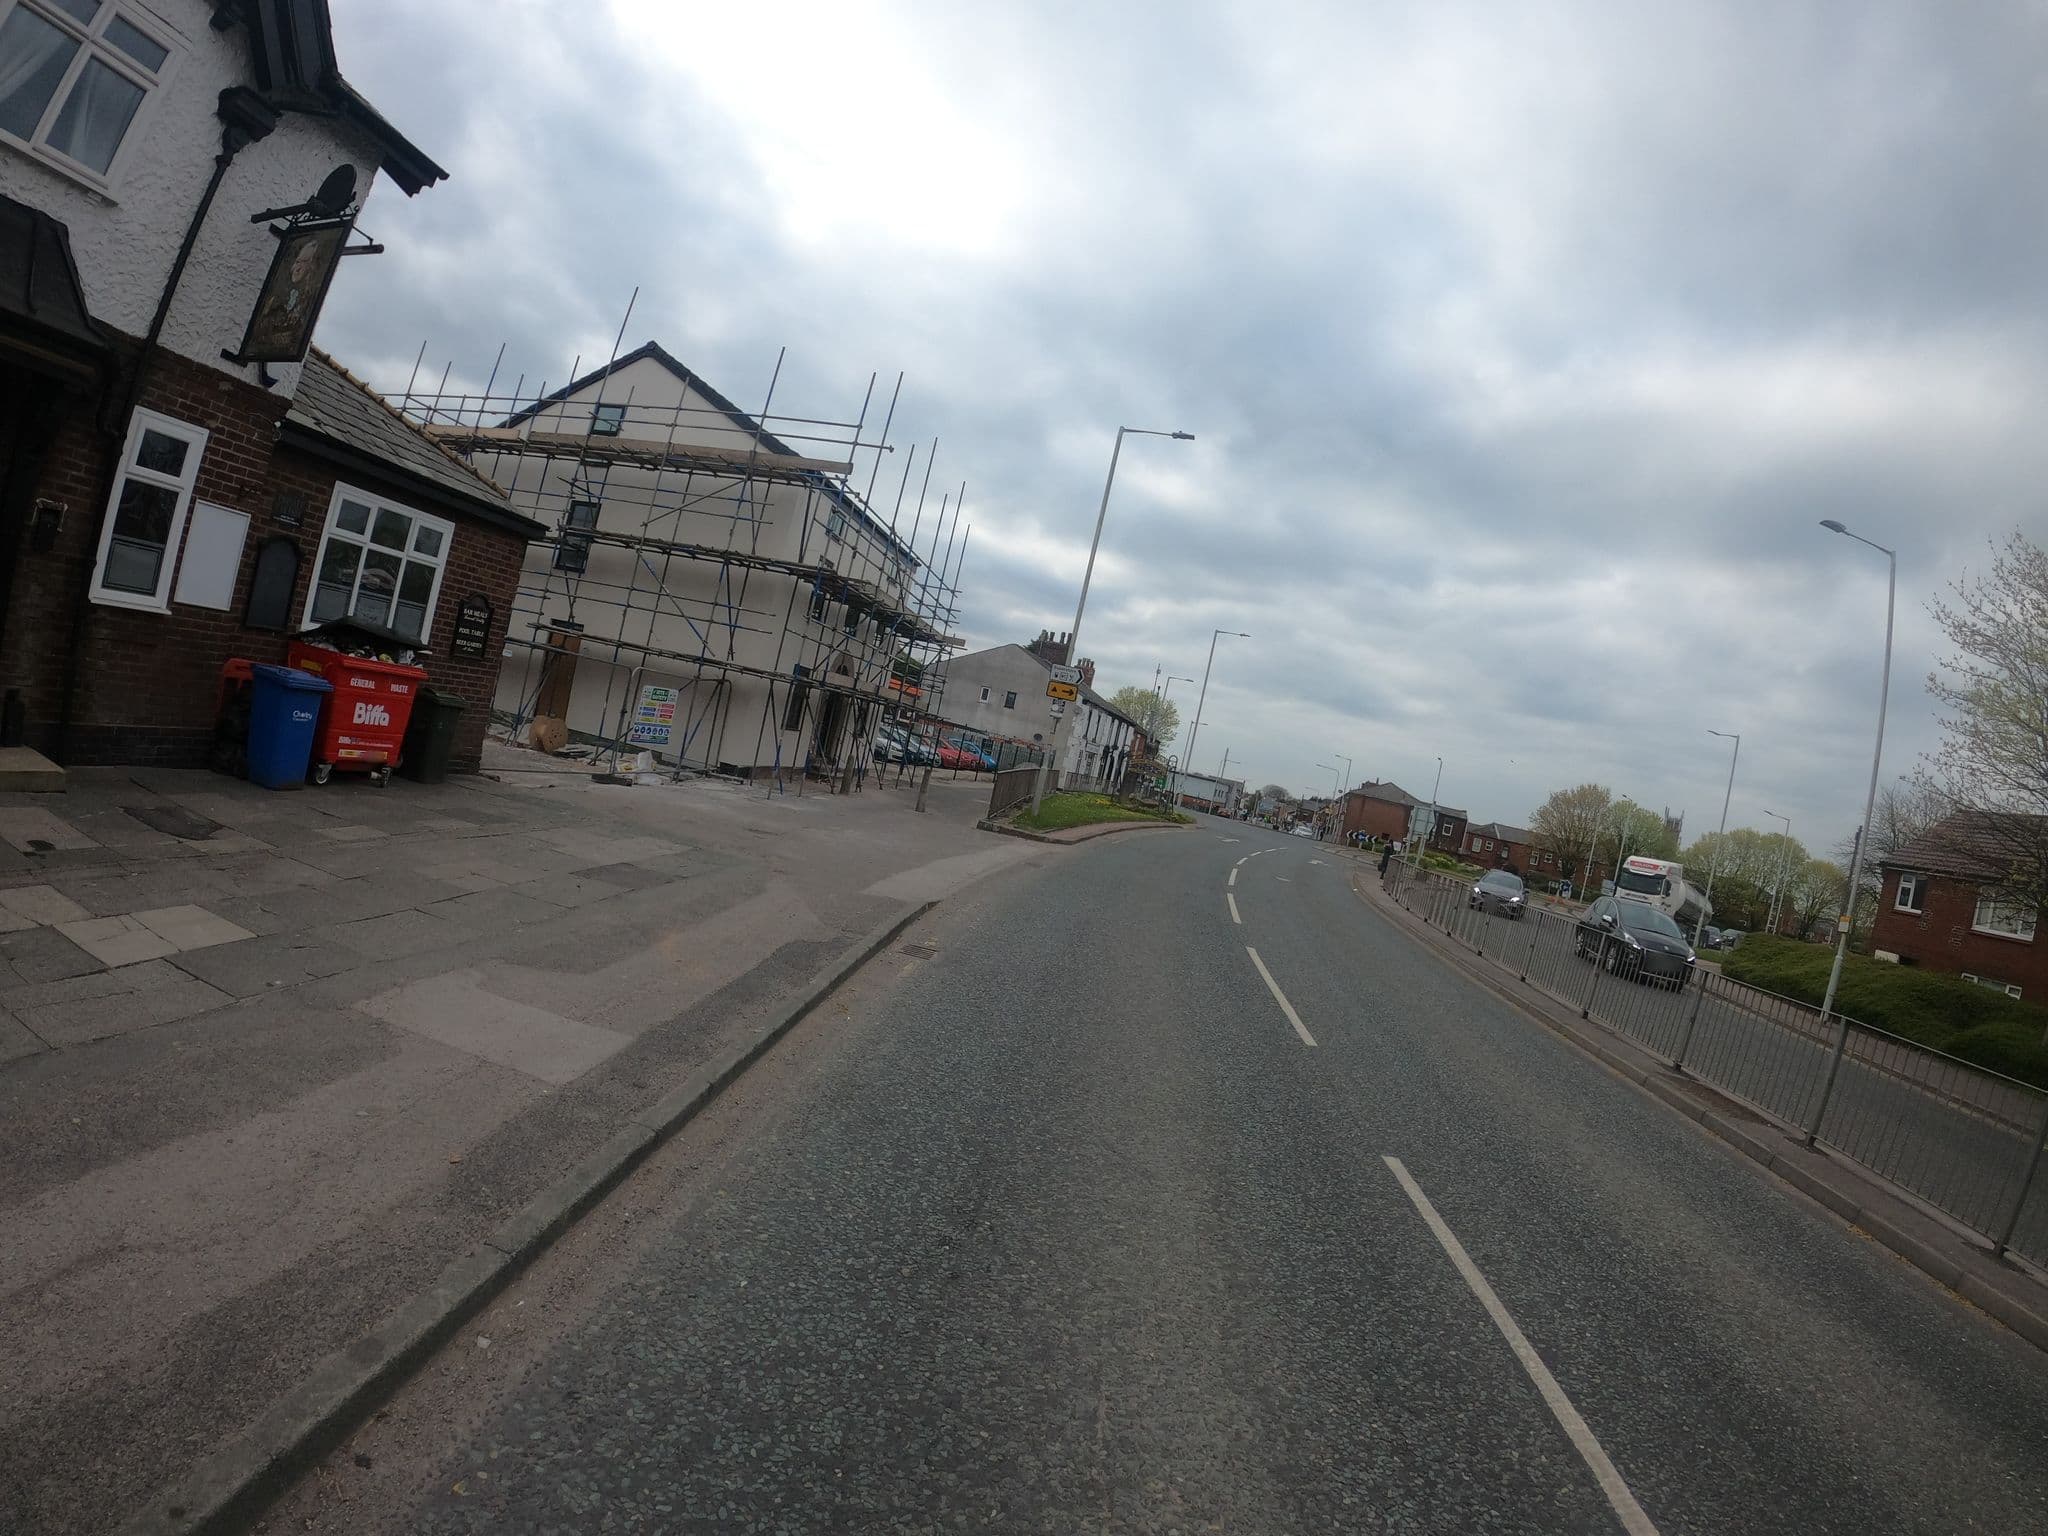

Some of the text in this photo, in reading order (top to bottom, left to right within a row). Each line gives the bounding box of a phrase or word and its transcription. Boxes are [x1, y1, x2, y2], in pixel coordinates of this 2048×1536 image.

[471, 629, 484, 637] TABLE
[350, 678, 409, 694] GENERAL WASTE
[352, 702, 390, 726] Biffa
